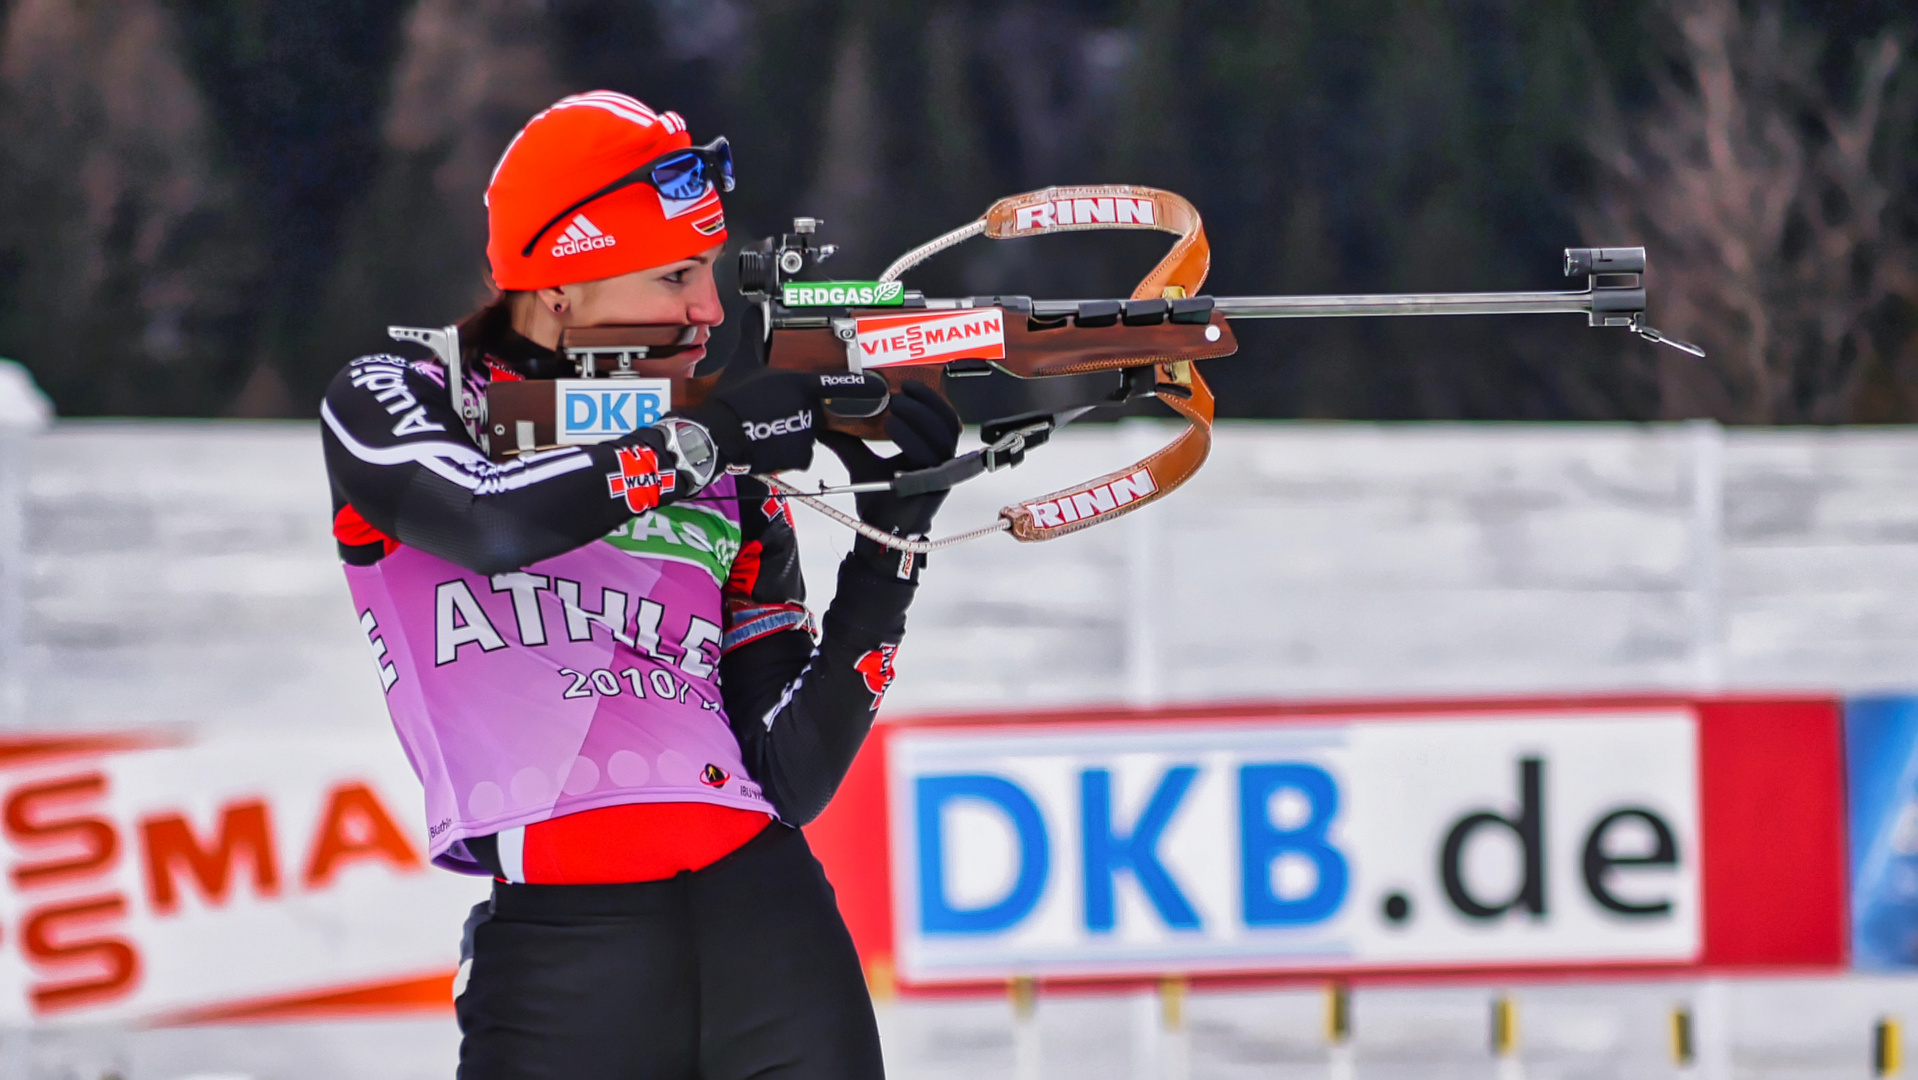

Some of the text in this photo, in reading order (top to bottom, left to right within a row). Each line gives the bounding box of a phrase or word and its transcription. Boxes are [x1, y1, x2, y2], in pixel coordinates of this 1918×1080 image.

[1016, 197, 1155, 230] RINN
[551, 234, 616, 257] adidas
[784, 287, 874, 305] ERDGAS
[860, 318, 1001, 359] VIESSMANN
[350, 365, 447, 437] Audi
[565, 392, 662, 432] DKB
[1027, 467, 1158, 529] RINN
[607, 510, 714, 553] AS
[435, 570, 722, 681] ATHLE
[558, 665, 721, 714] 2010/
[912, 755, 1680, 937] DKB.de
